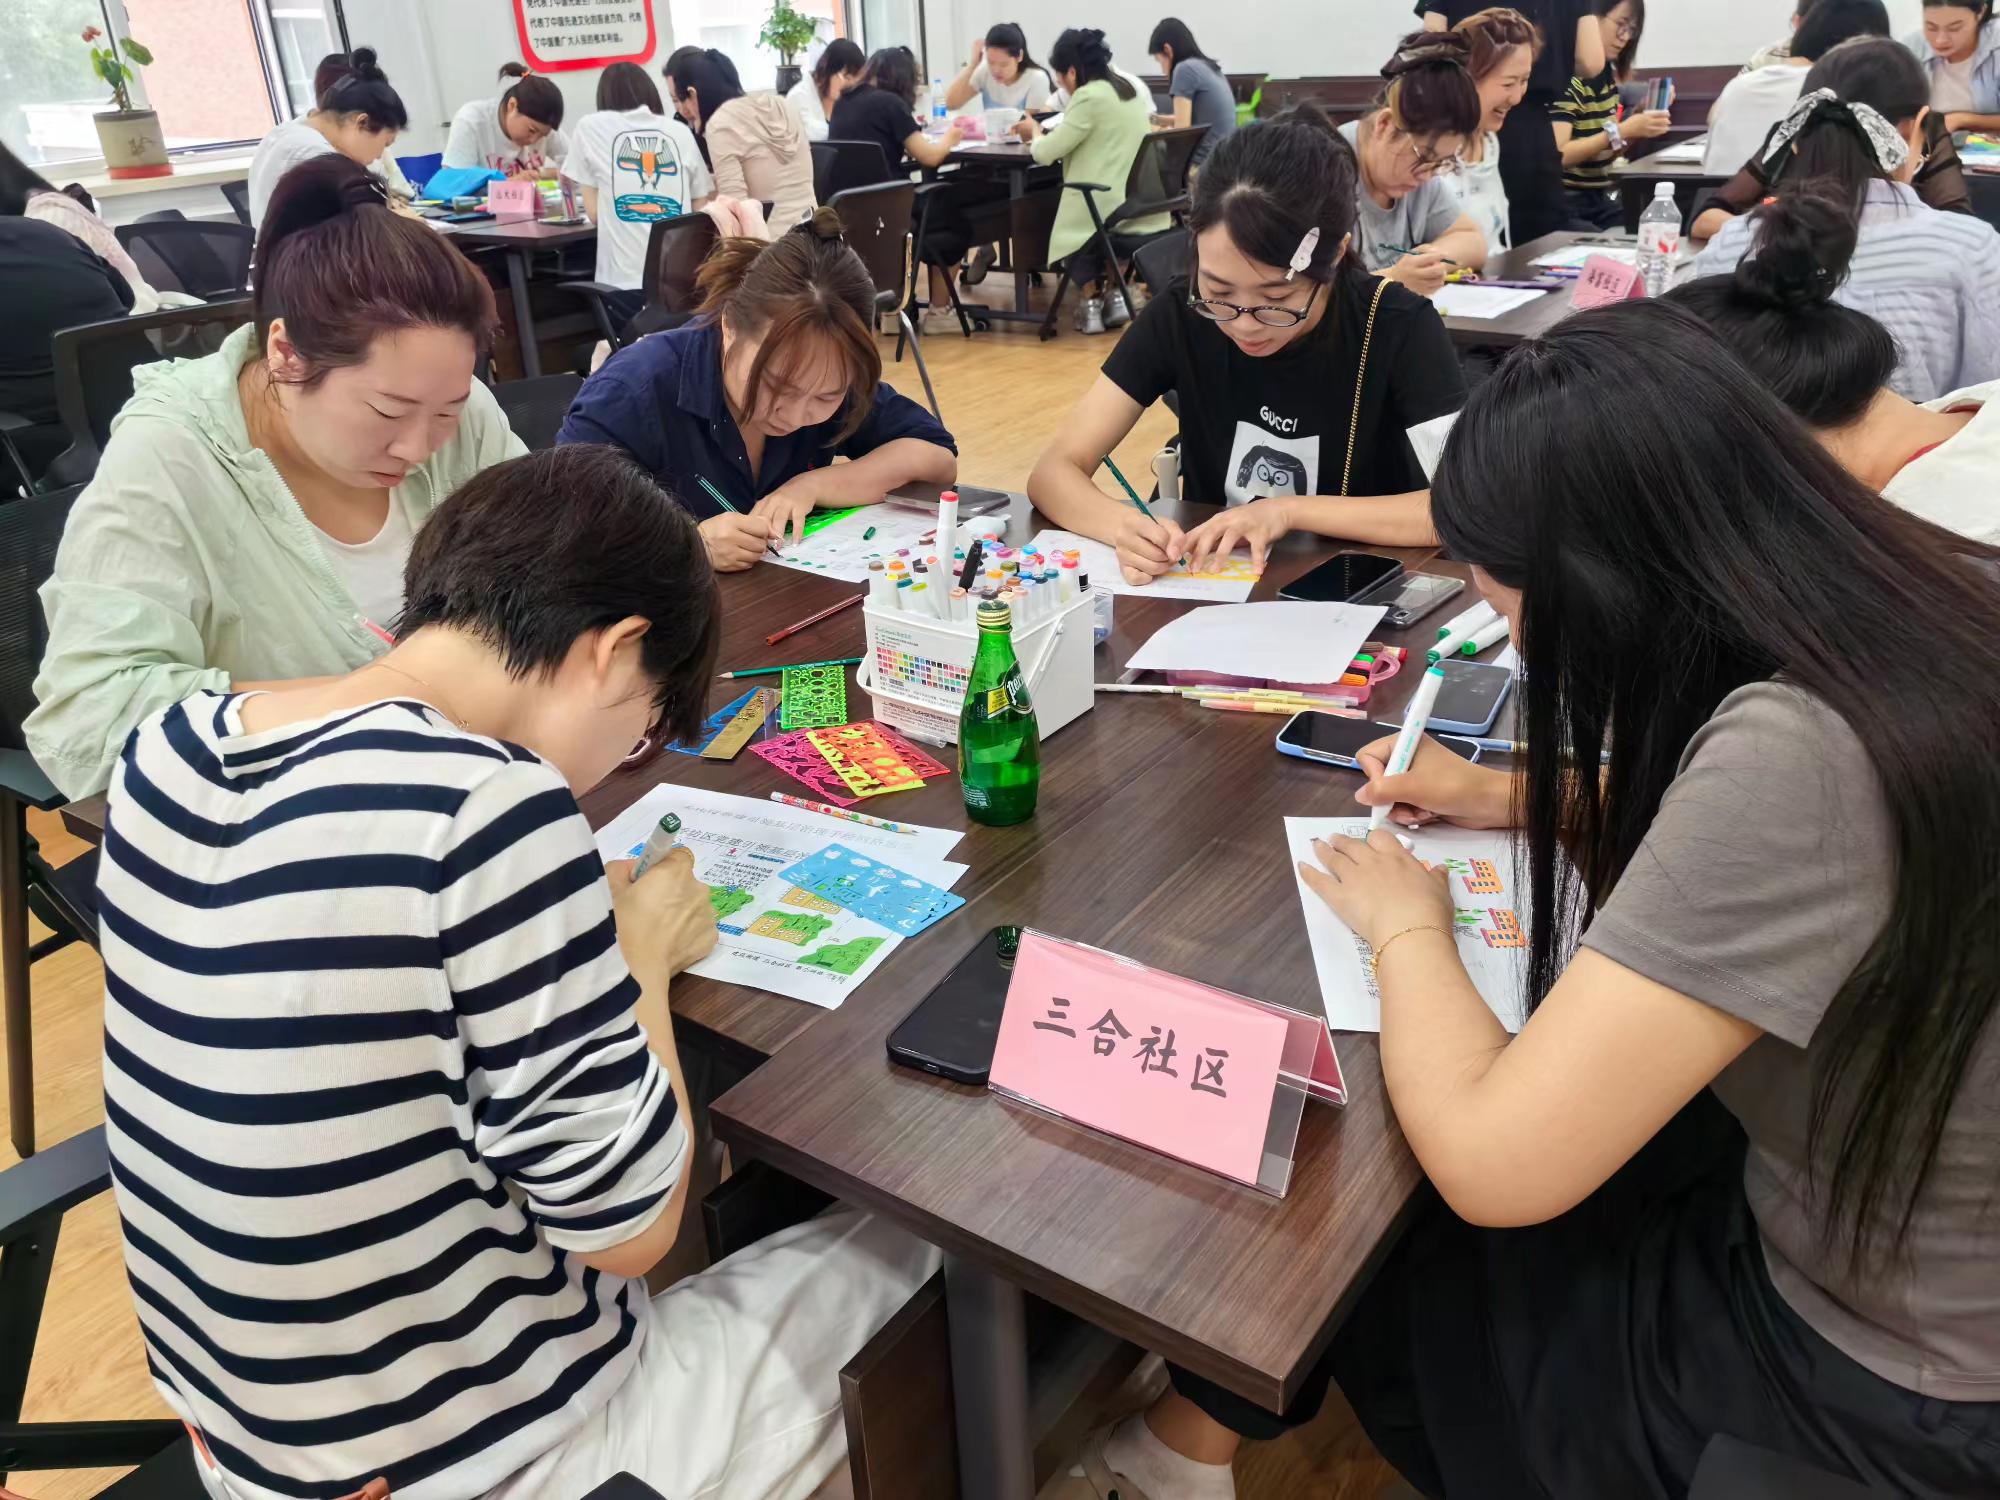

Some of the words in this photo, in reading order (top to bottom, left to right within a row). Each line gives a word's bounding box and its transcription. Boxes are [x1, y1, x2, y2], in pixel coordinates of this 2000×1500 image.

[1259, 405, 1299, 433] GUCCI
[1032, 996, 1231, 1099] 三合社区
